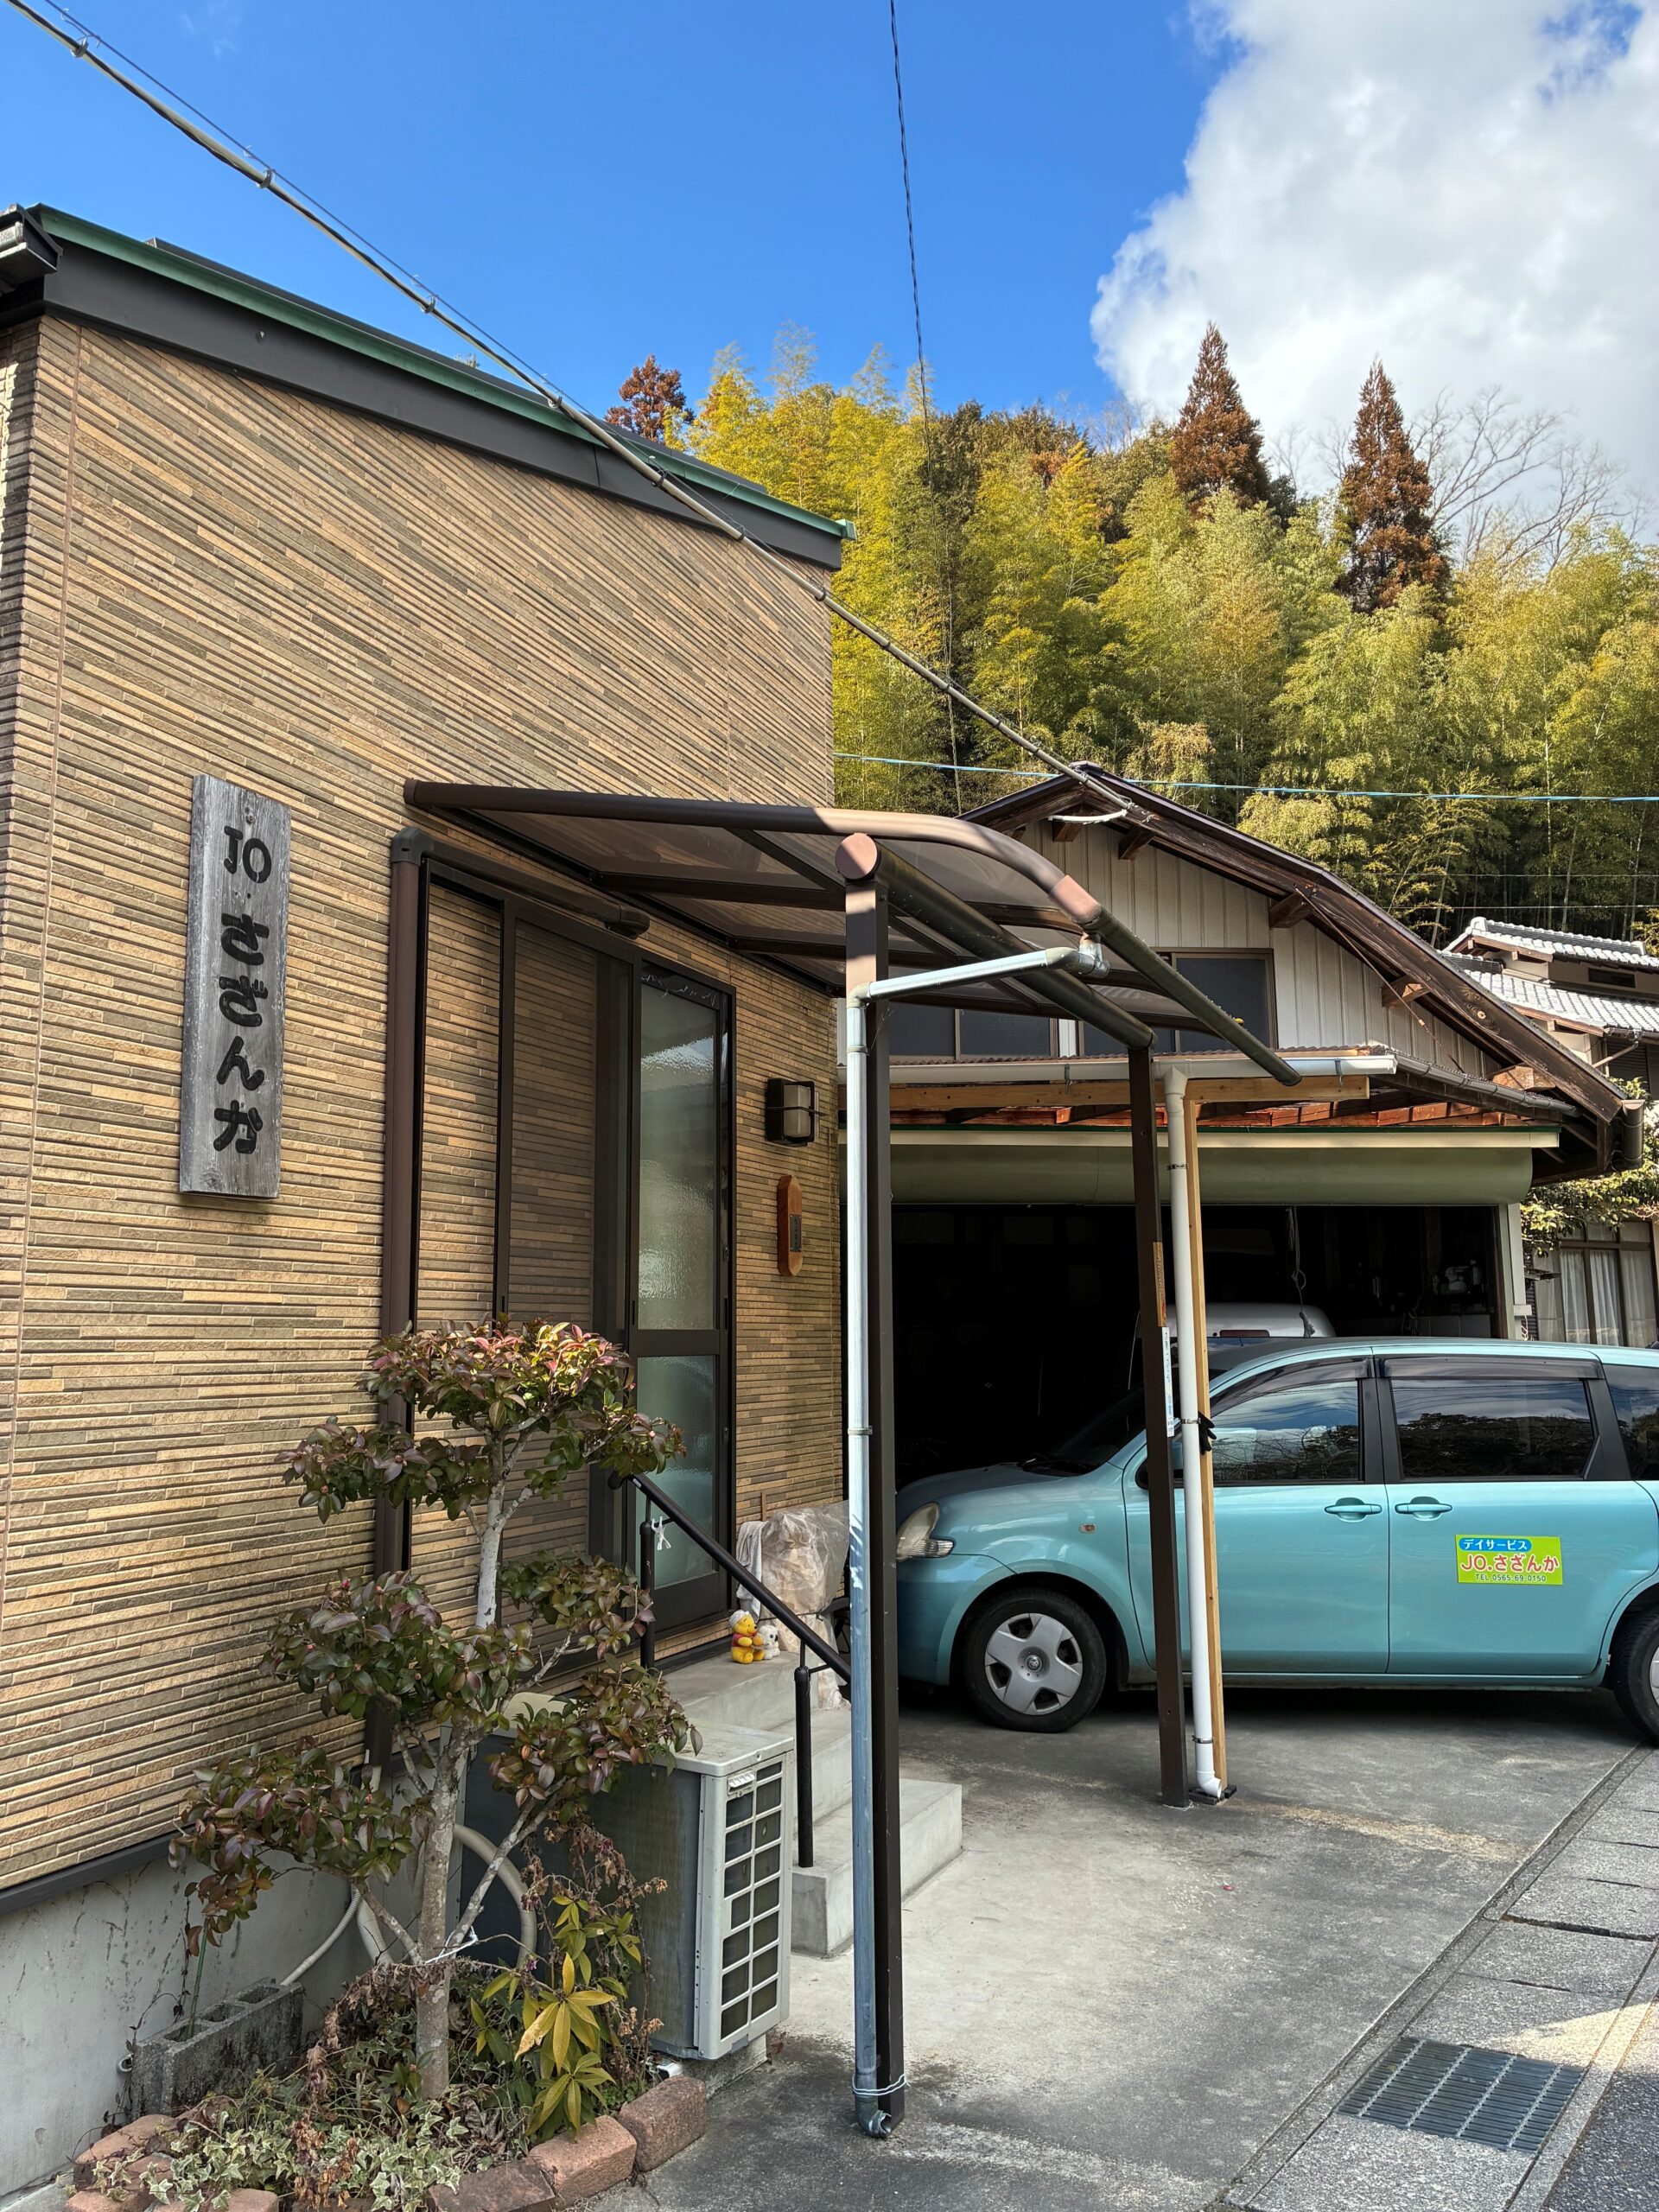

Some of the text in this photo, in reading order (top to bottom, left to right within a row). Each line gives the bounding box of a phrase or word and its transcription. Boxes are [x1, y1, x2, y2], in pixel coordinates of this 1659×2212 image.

[1463, 1539, 1528, 1550] デイサービス
